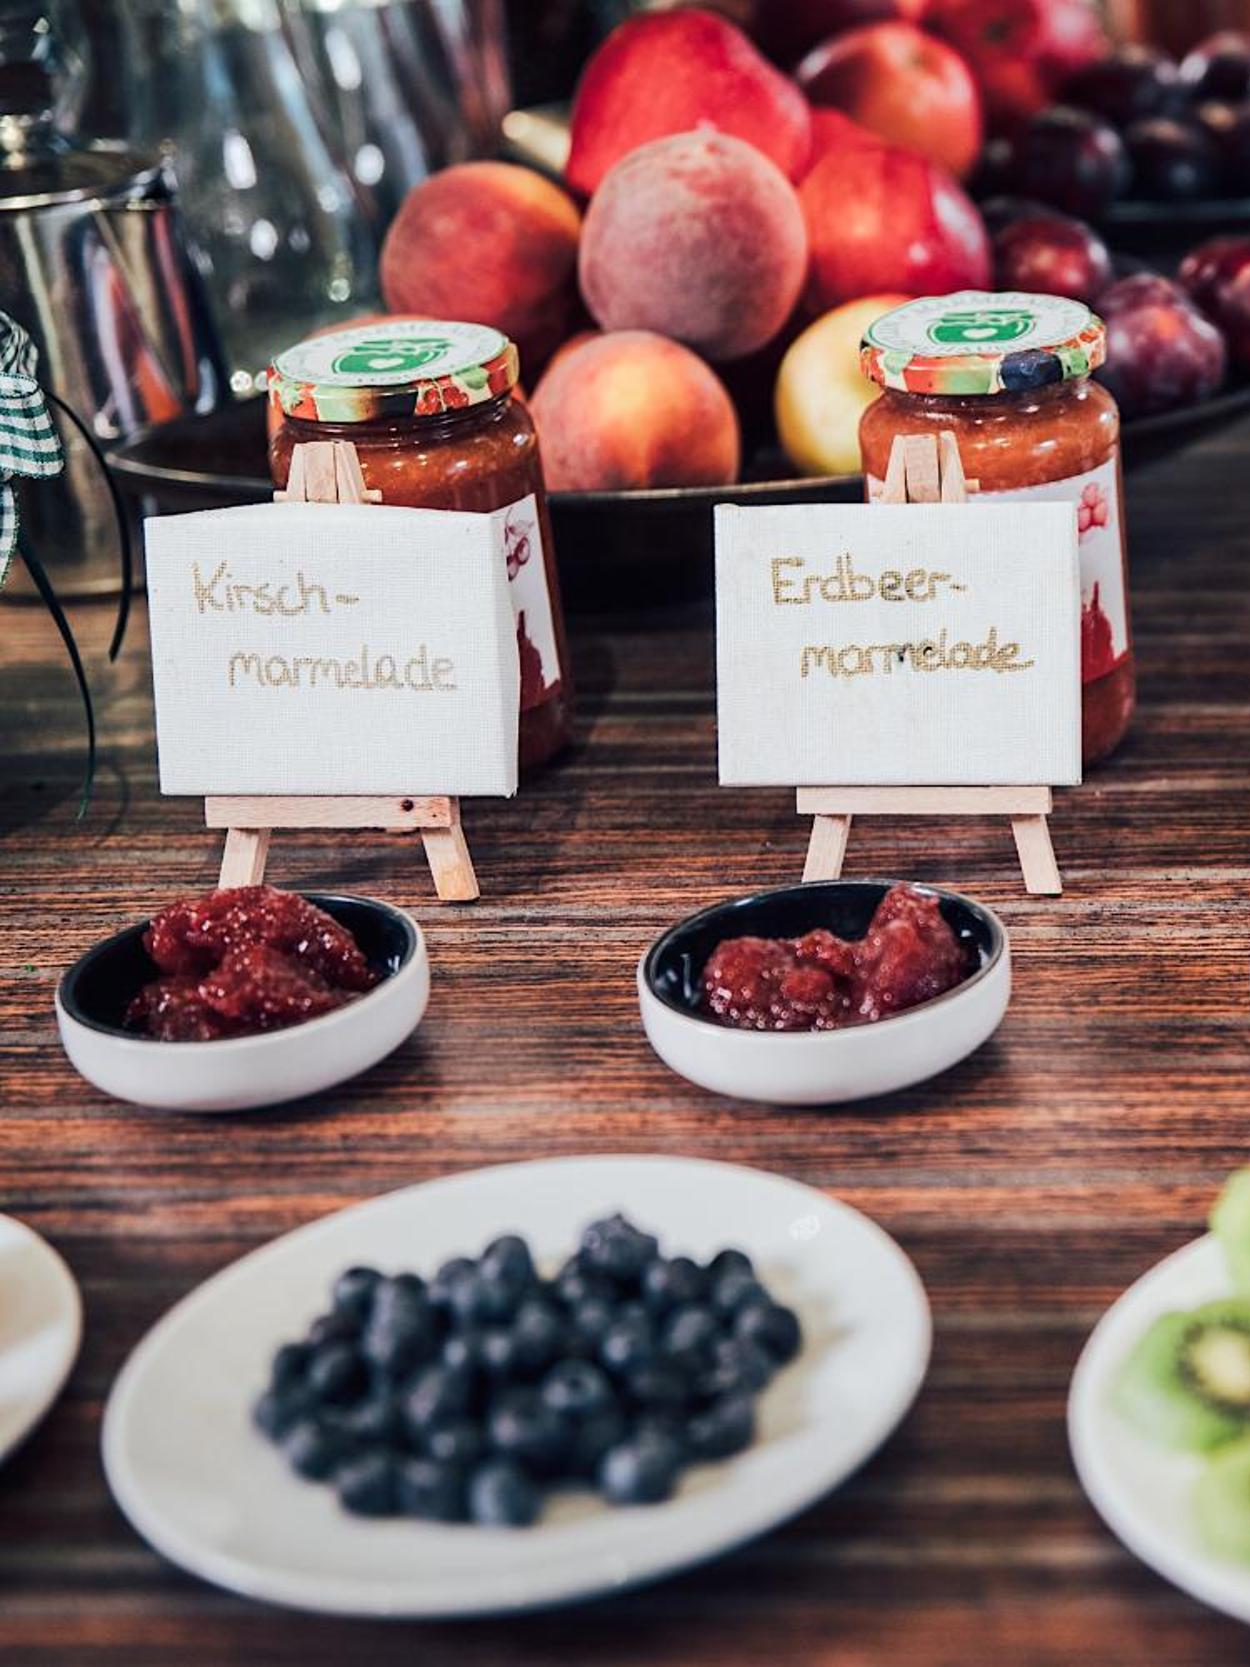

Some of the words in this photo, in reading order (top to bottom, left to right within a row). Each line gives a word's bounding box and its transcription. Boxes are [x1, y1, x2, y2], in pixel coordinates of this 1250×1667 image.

[191, 560, 360, 616] Kirsch-
[771, 552, 967, 605] Erdbeer-
[226, 644, 457, 690] marmelade
[801, 626, 1034, 679] marmelade
